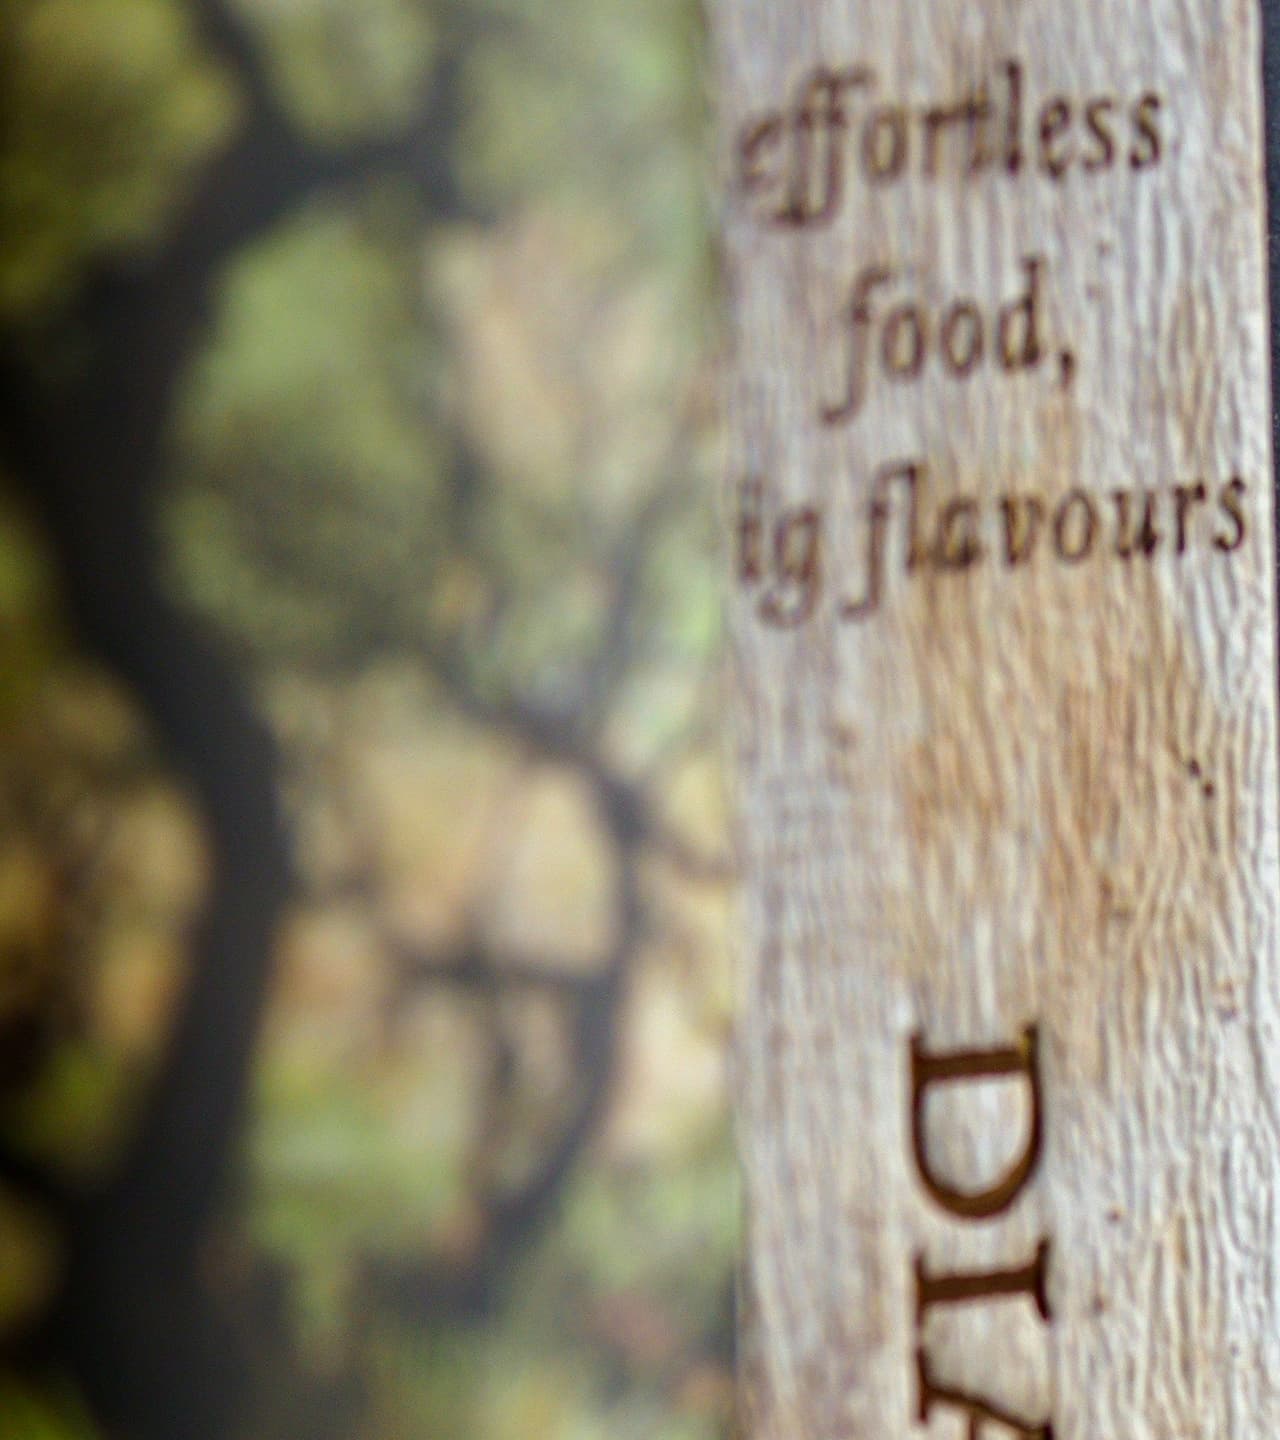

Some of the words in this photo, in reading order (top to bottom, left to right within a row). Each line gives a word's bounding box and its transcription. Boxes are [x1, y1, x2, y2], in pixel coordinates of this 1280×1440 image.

[734, 58, 1166, 230] effortless
[822, 255, 1079, 427] food,
[735, 472, 824, 628] ig
[836, 458, 1247, 622] flavours
